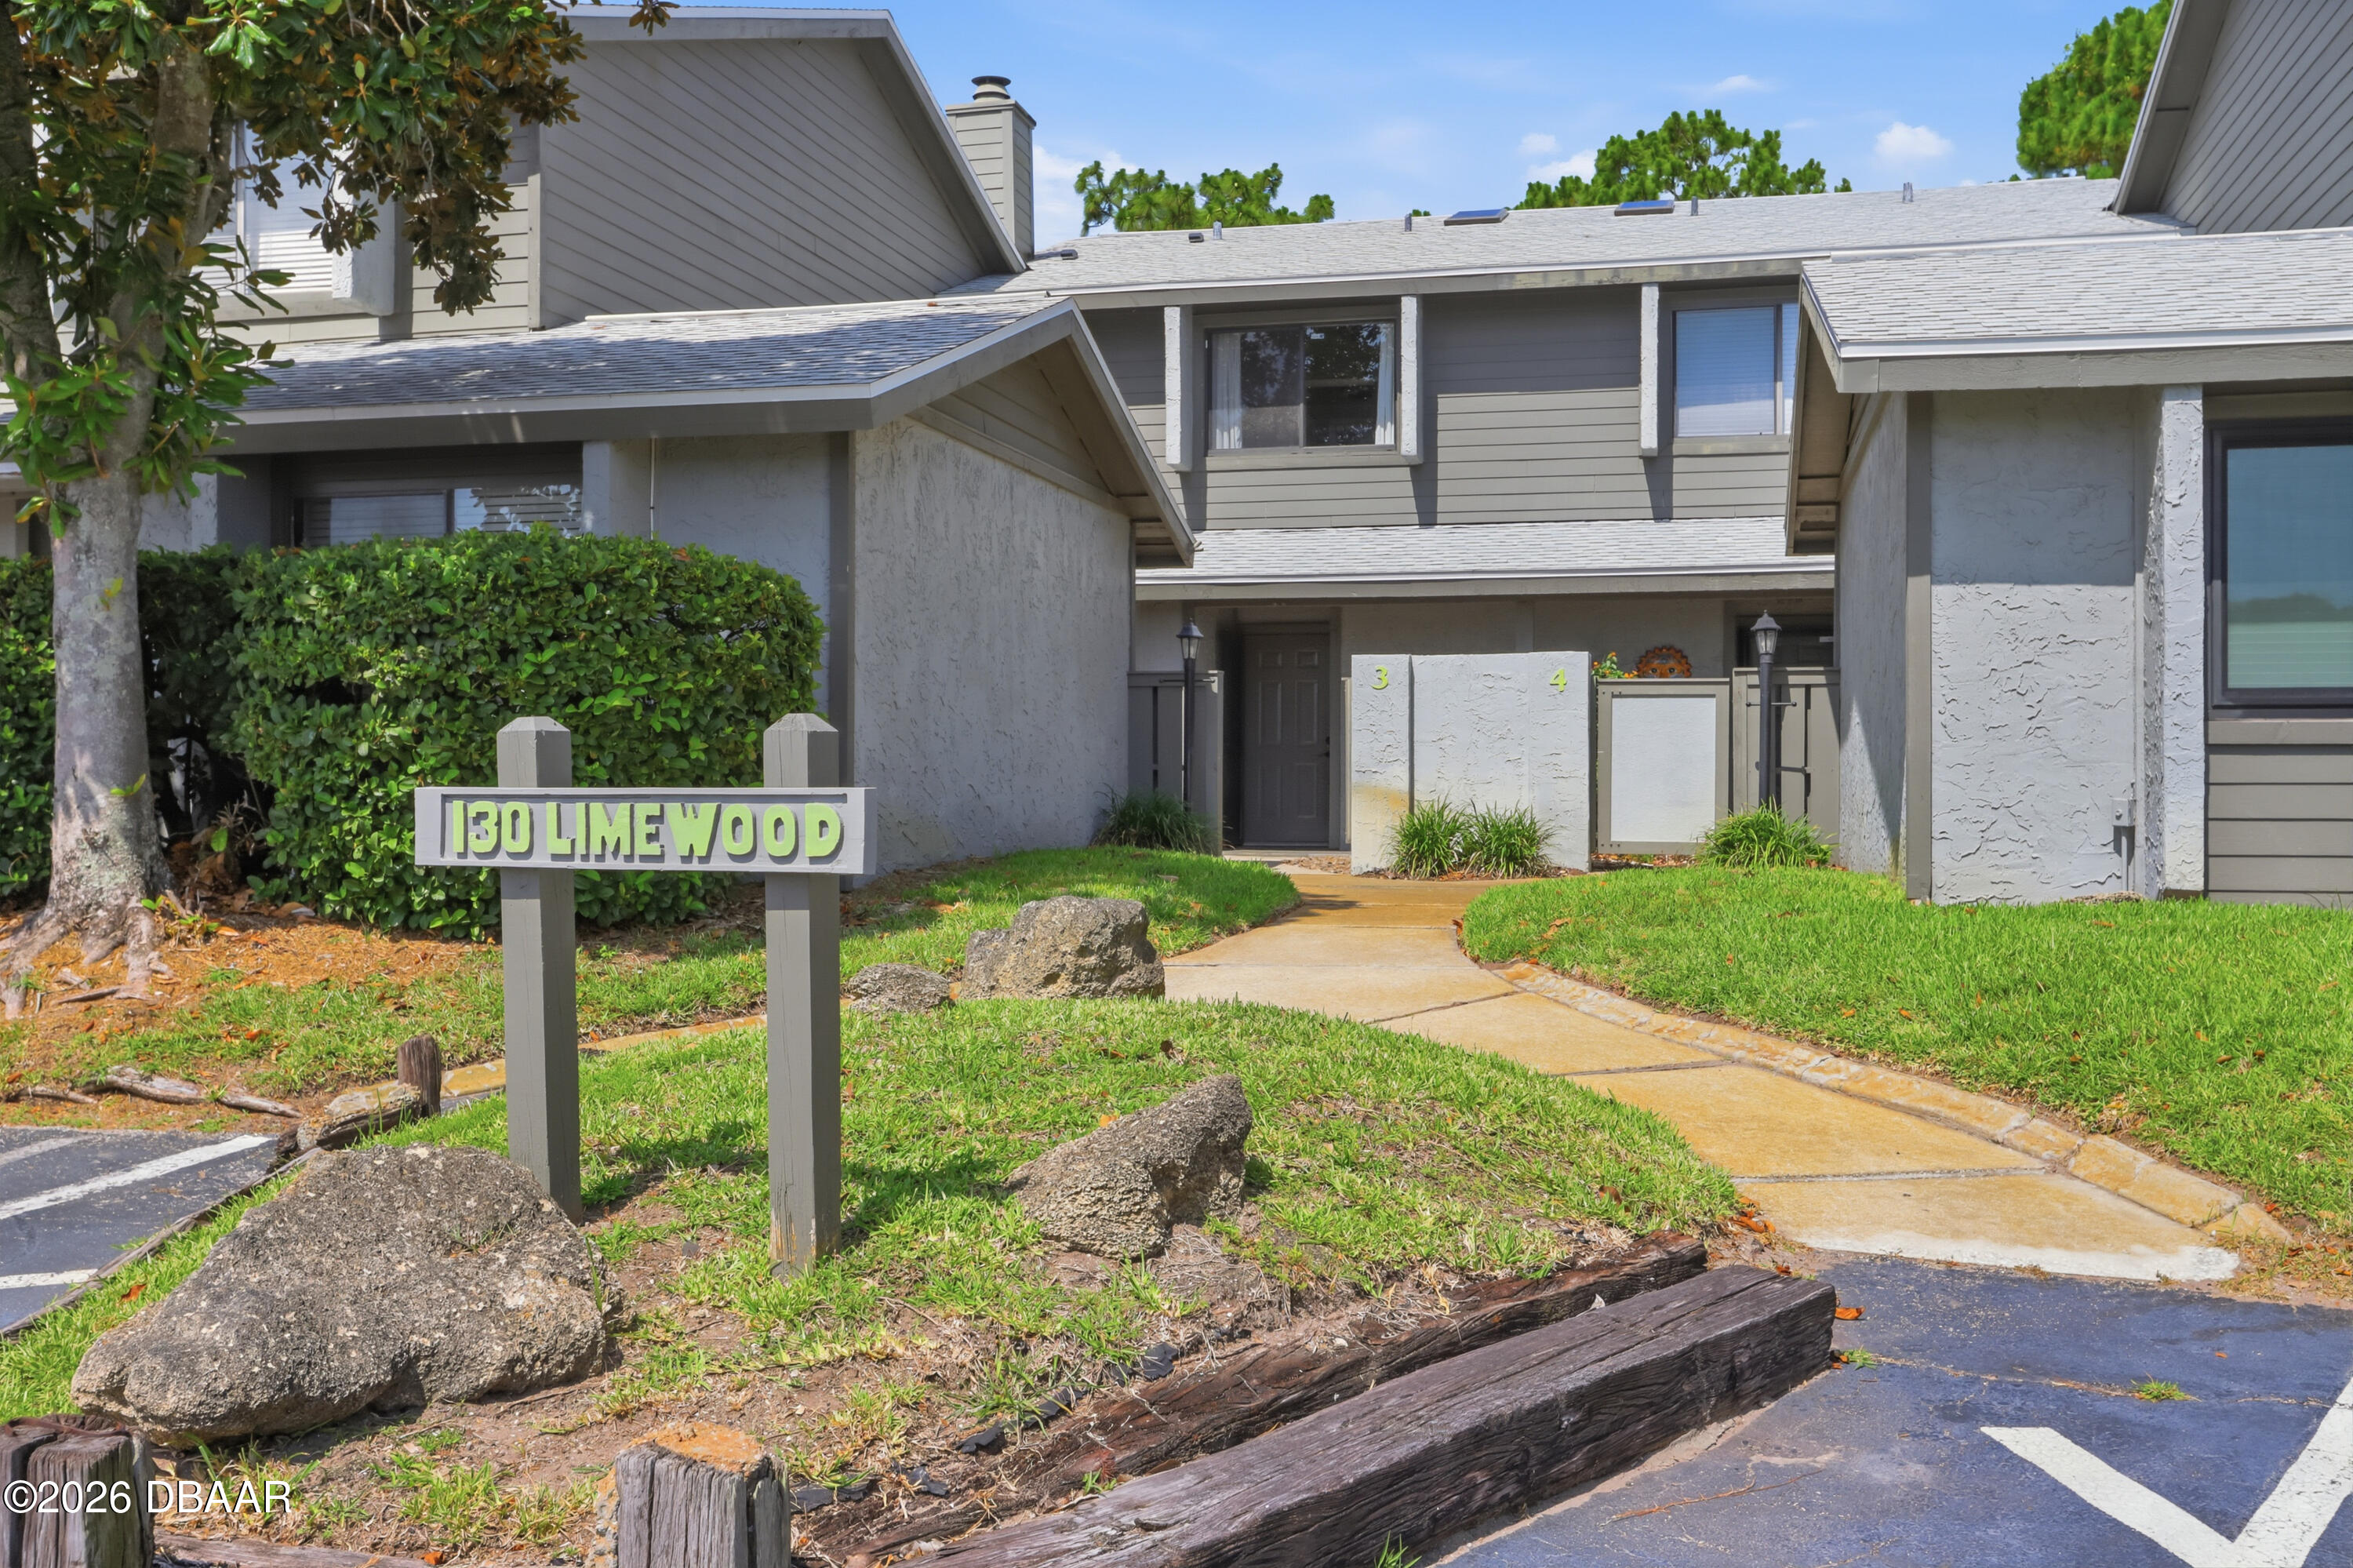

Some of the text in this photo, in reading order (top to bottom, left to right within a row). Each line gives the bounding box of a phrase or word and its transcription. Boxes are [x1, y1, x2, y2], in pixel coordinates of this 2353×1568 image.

[1372, 666, 1388, 689] 3
[1549, 668, 1566, 692] 4
[453, 800, 842, 857] 130 LIMEWOOD
